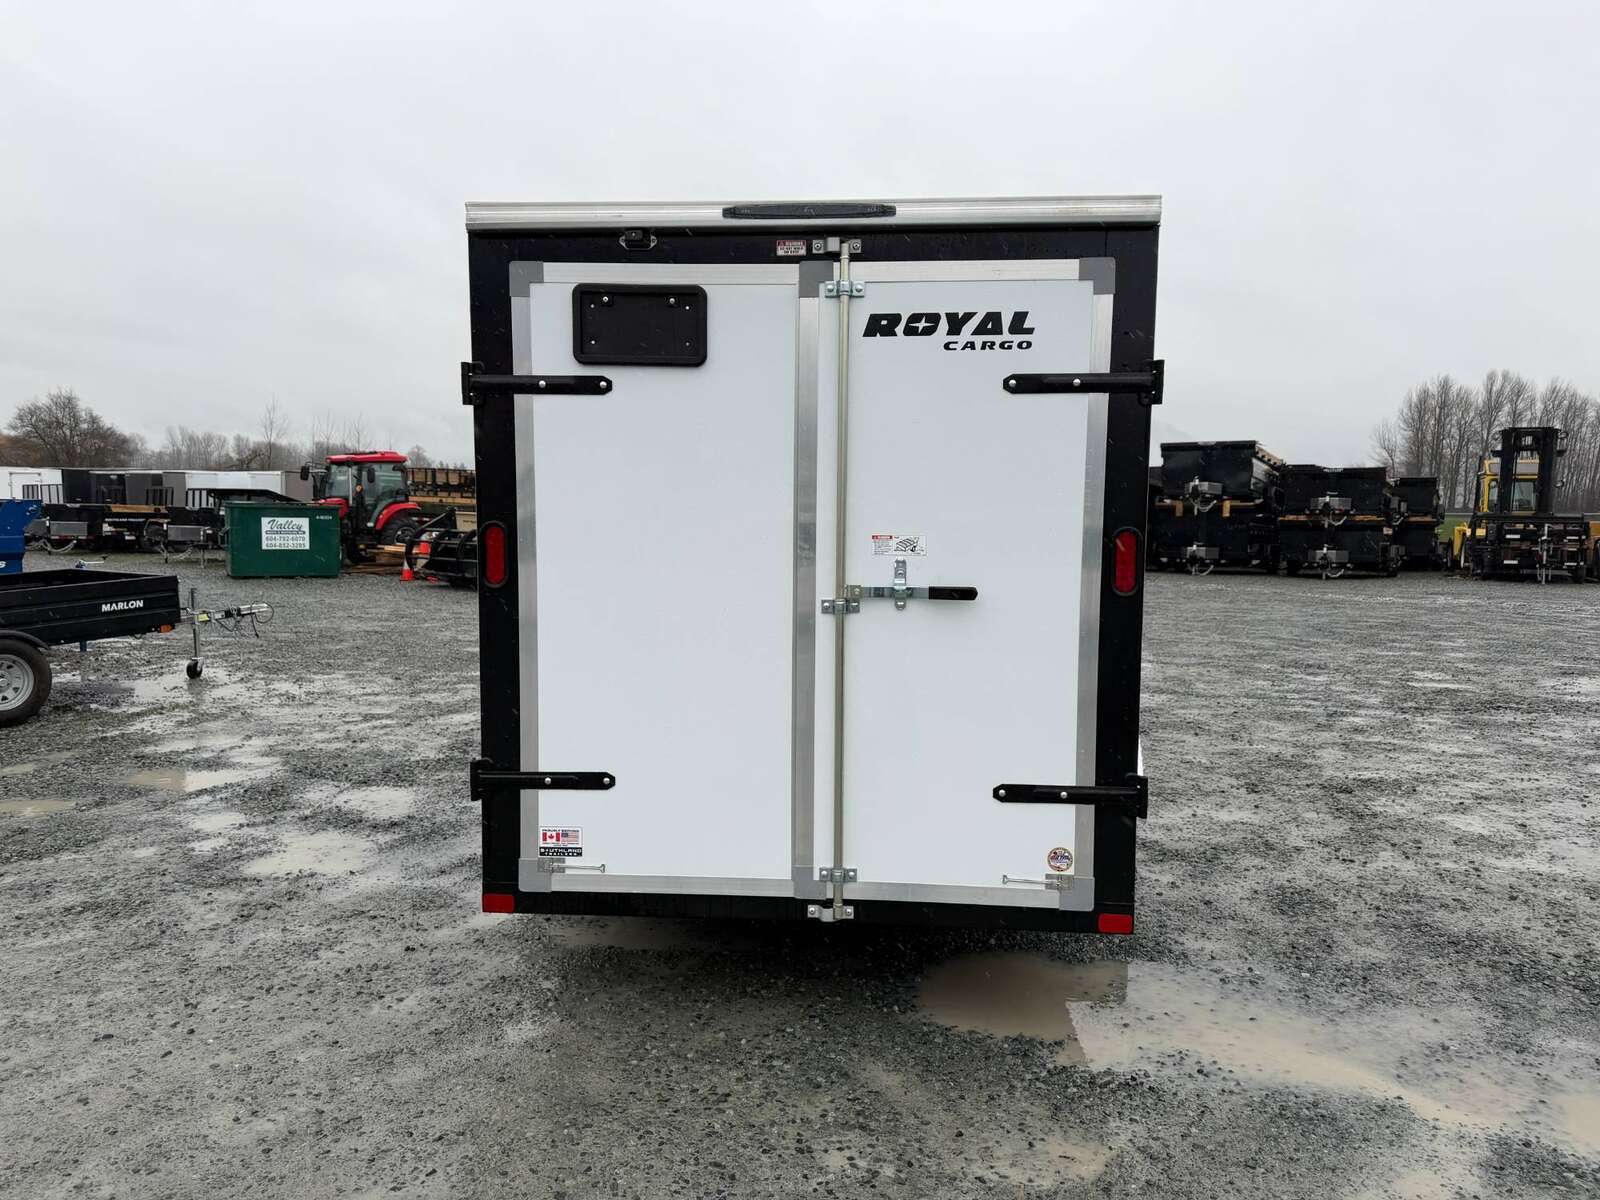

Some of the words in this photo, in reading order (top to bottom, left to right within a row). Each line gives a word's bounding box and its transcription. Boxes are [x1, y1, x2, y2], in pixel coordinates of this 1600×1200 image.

[862, 311, 1036, 338] ROYAL
[943, 340, 1033, 351] CARGO
[267, 518, 303, 531] Valley
[101, 599, 144, 613] MARLON
